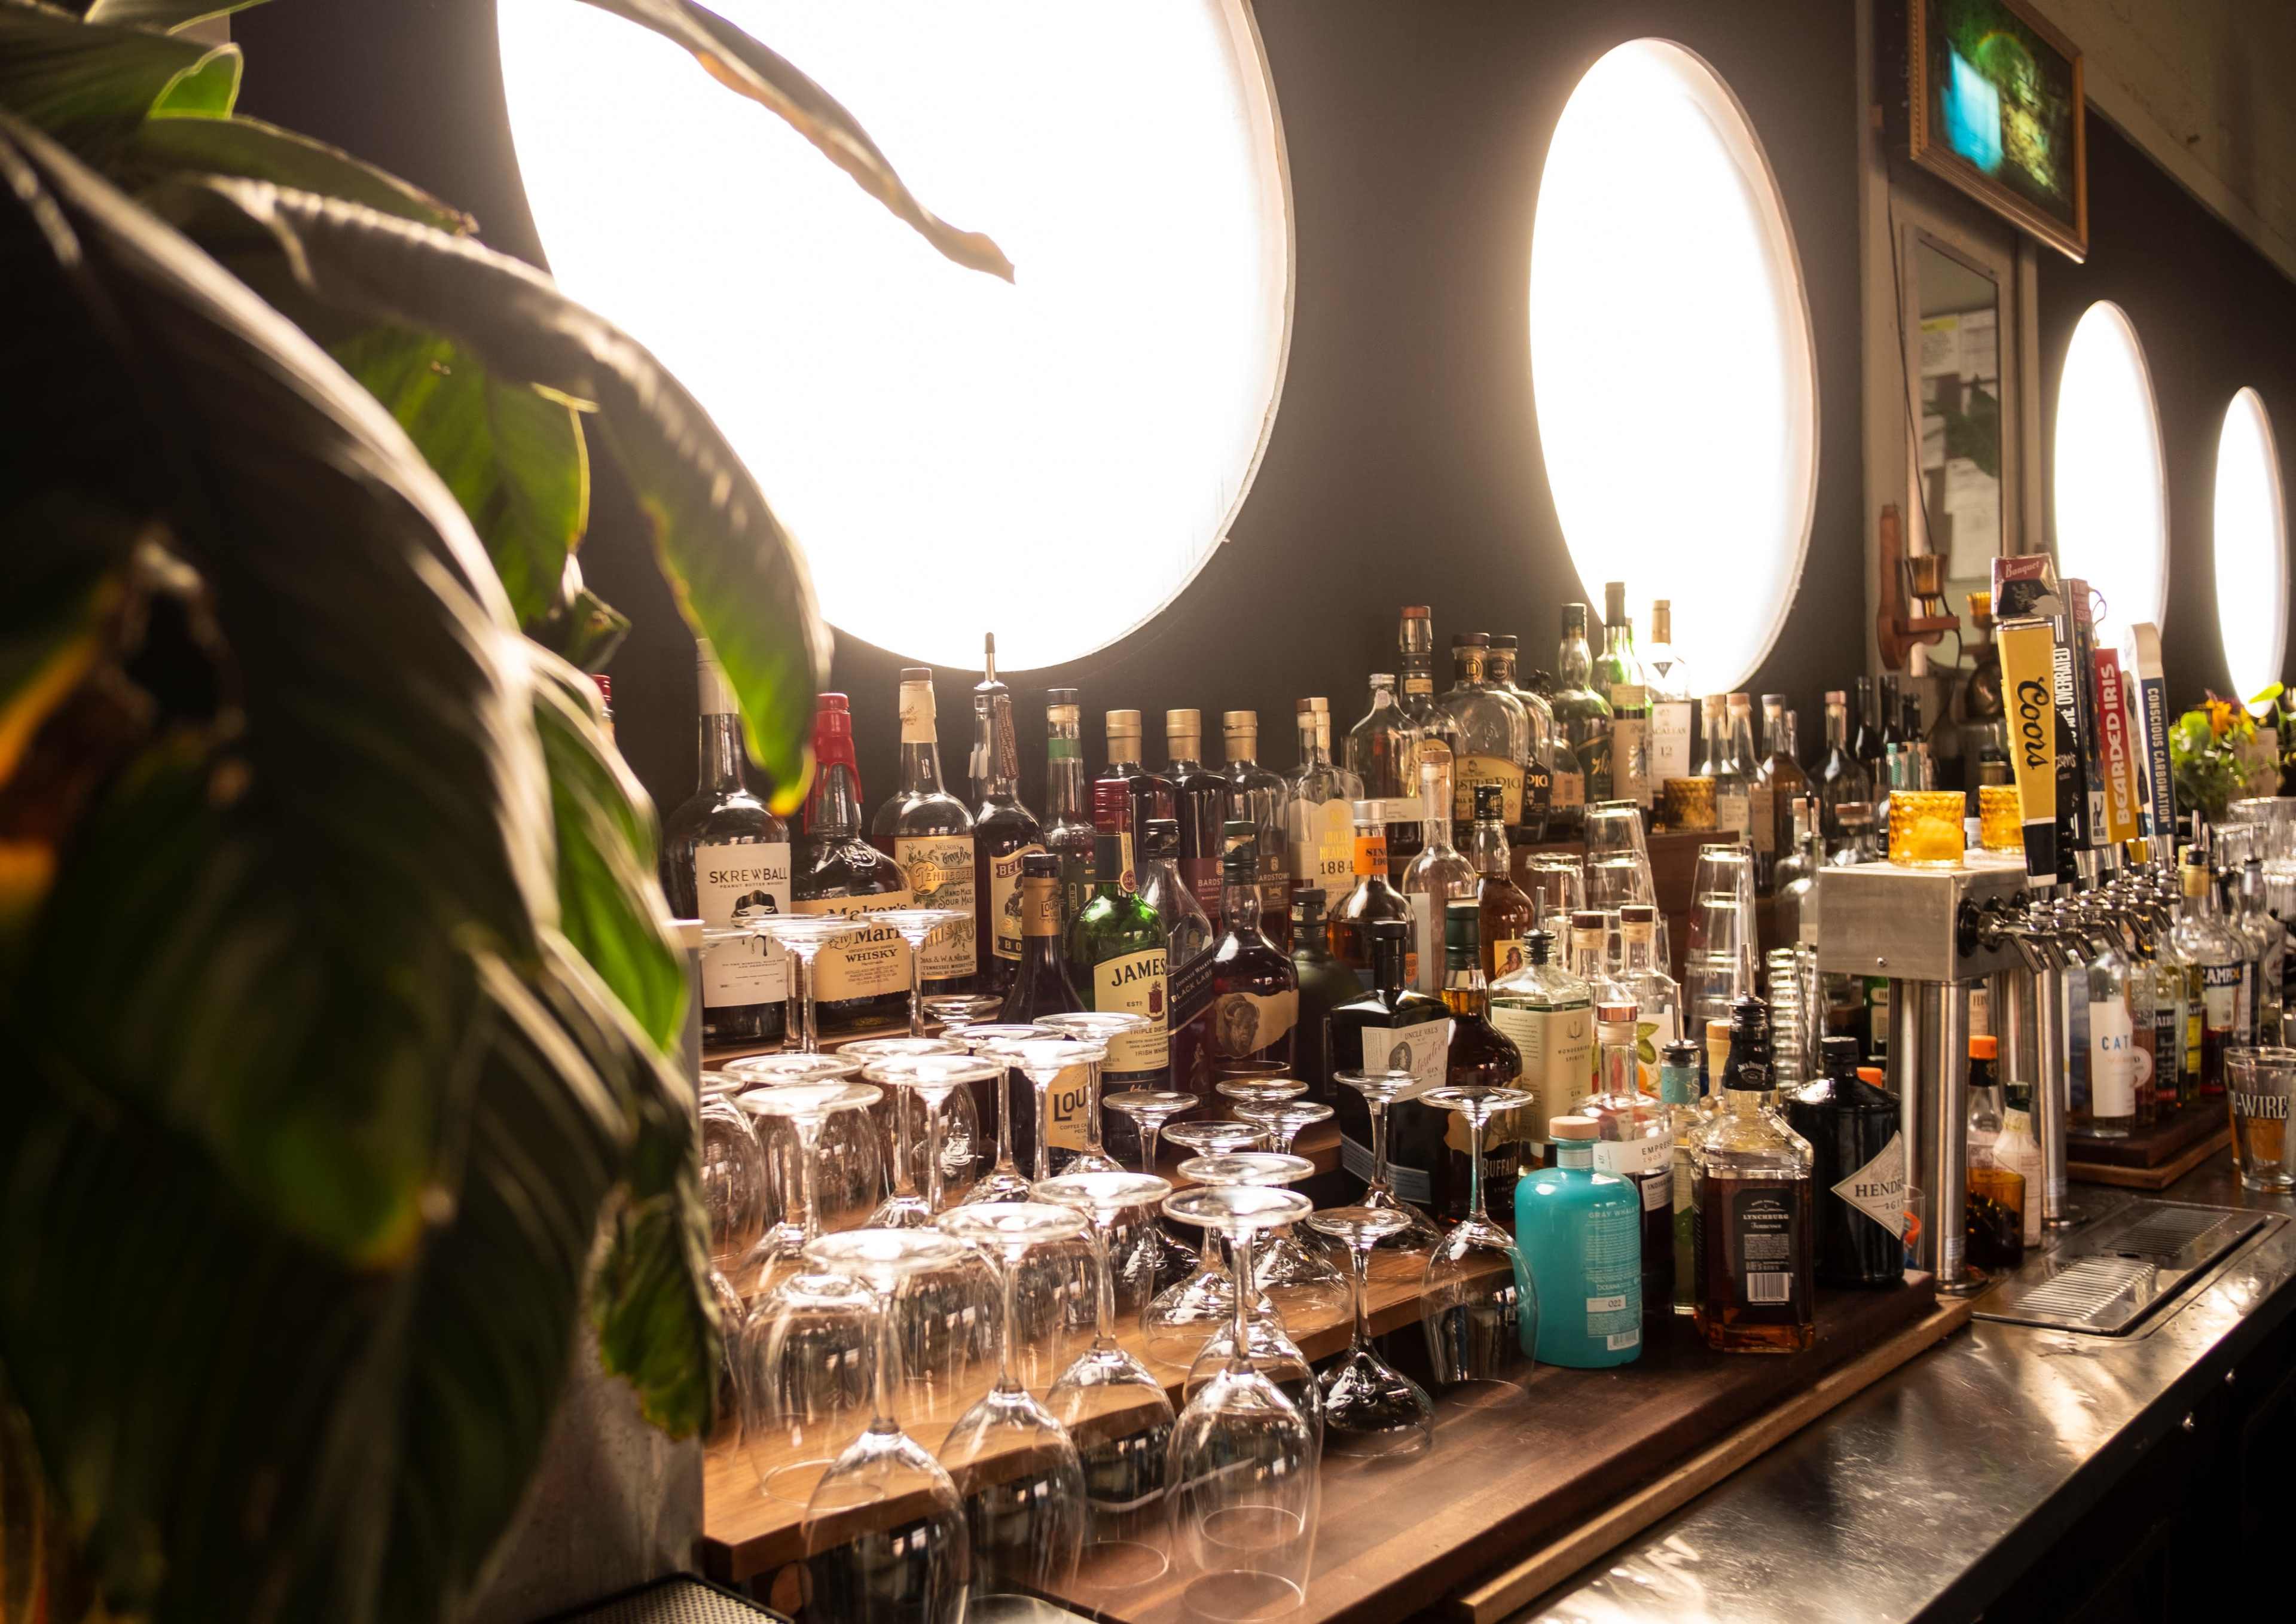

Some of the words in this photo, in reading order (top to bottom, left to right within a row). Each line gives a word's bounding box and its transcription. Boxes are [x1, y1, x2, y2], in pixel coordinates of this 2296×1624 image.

[2005, 561, 2039, 578] Banquet
[2053, 647, 2074, 706] OVERRATED
[2100, 663, 2119, 709] IRIS
[2017, 676, 2050, 770] Coors
[2147, 688, 2164, 747] CONSCIOUS
[1661, 746, 1672, 756] 12
[2106, 713, 2130, 825] BEARDED
[2153, 750, 2170, 823] CARBONATION
[709, 868, 787, 883] SKREWBALL
[915, 866, 973, 889] TENNESSEE
[1258, 873, 1290, 881] ARDSTOWN
[1320, 860, 1354, 875] 1884
[845, 948, 897, 963] WHISKY
[1171, 982, 1195, 1003] BLACK
[2102, 1034, 2133, 1051] CAT
[1482, 1155, 1518, 1179] BUFFALO
